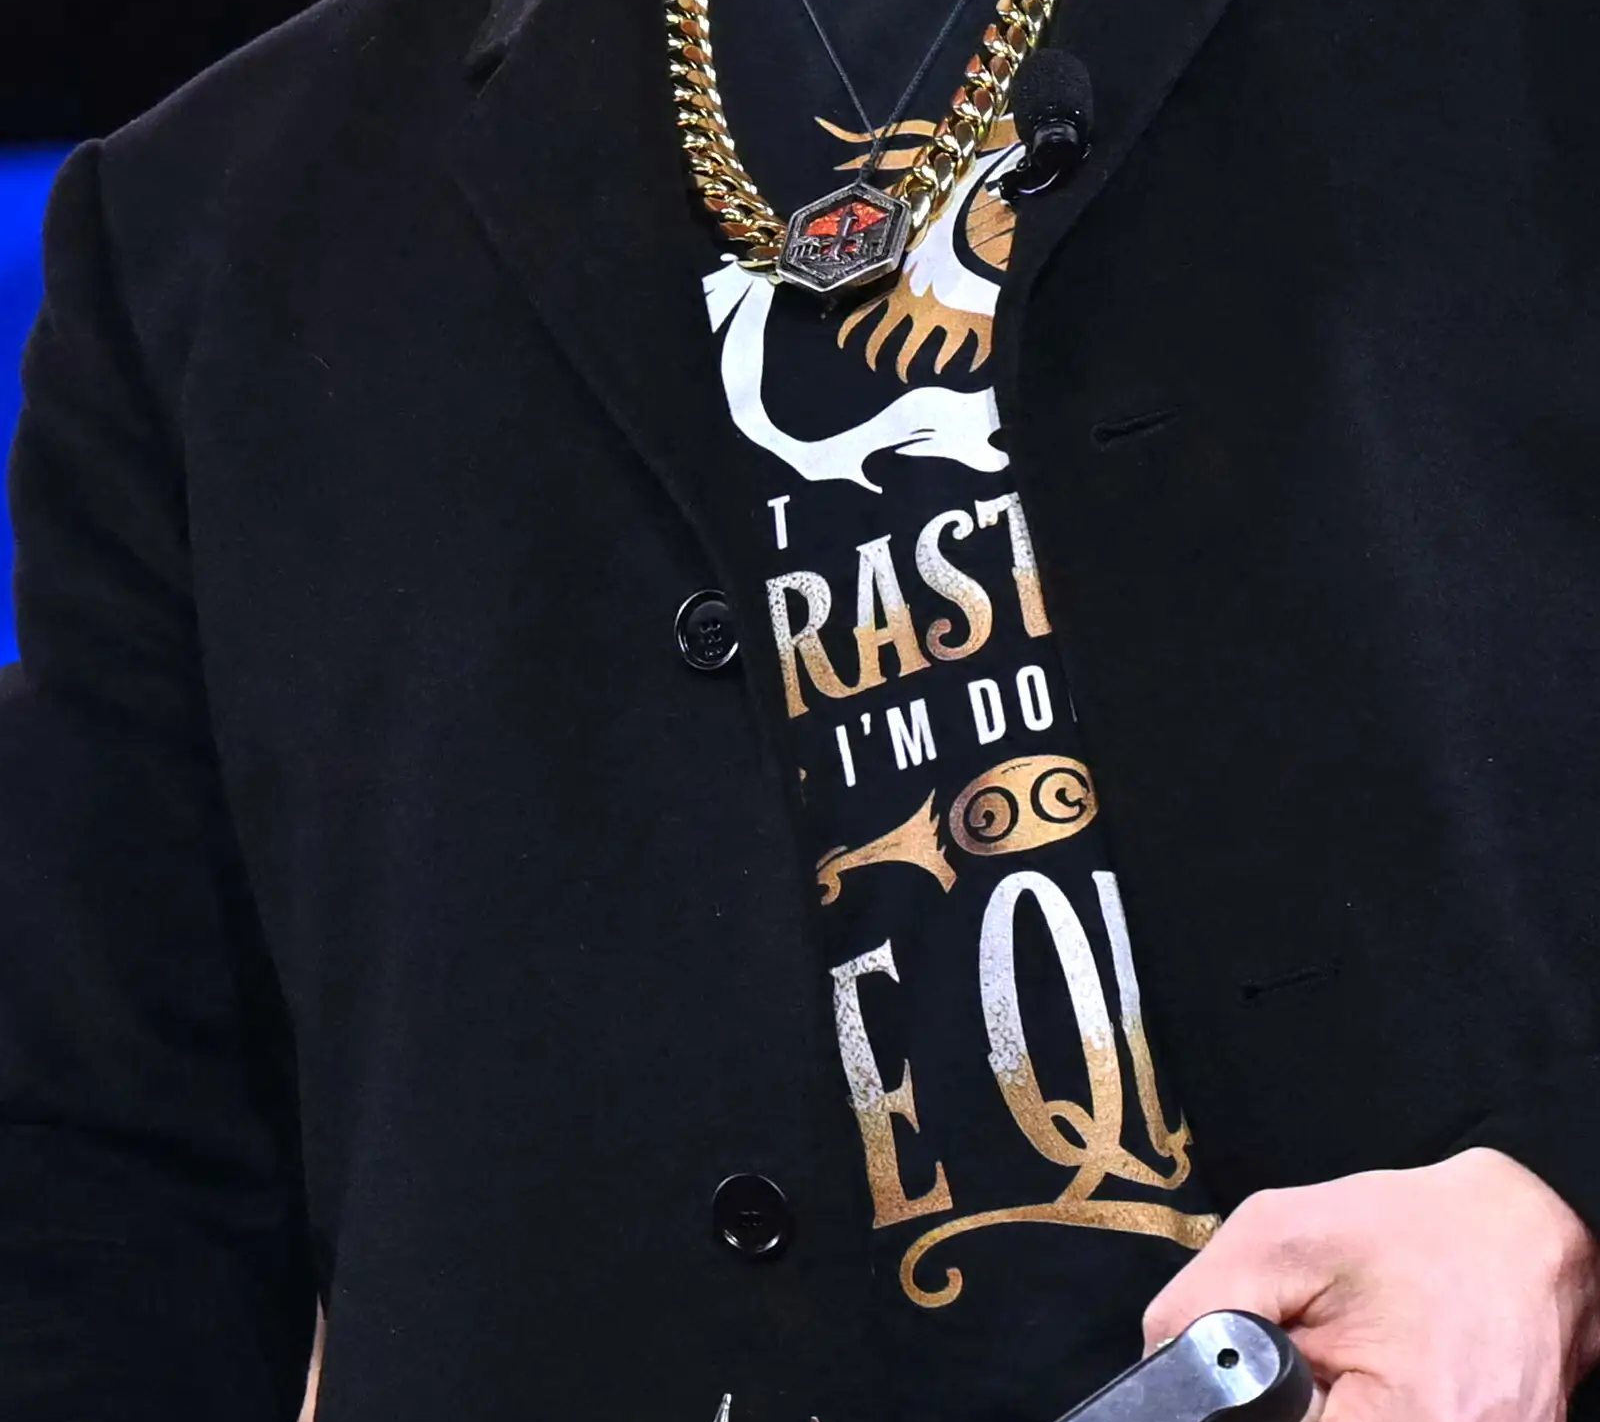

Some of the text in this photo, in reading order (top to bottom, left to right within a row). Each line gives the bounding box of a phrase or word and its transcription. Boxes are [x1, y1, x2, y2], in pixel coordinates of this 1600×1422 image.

[766, 491, 1053, 719] RAST
[835, 665, 1054, 787] I'M DO
